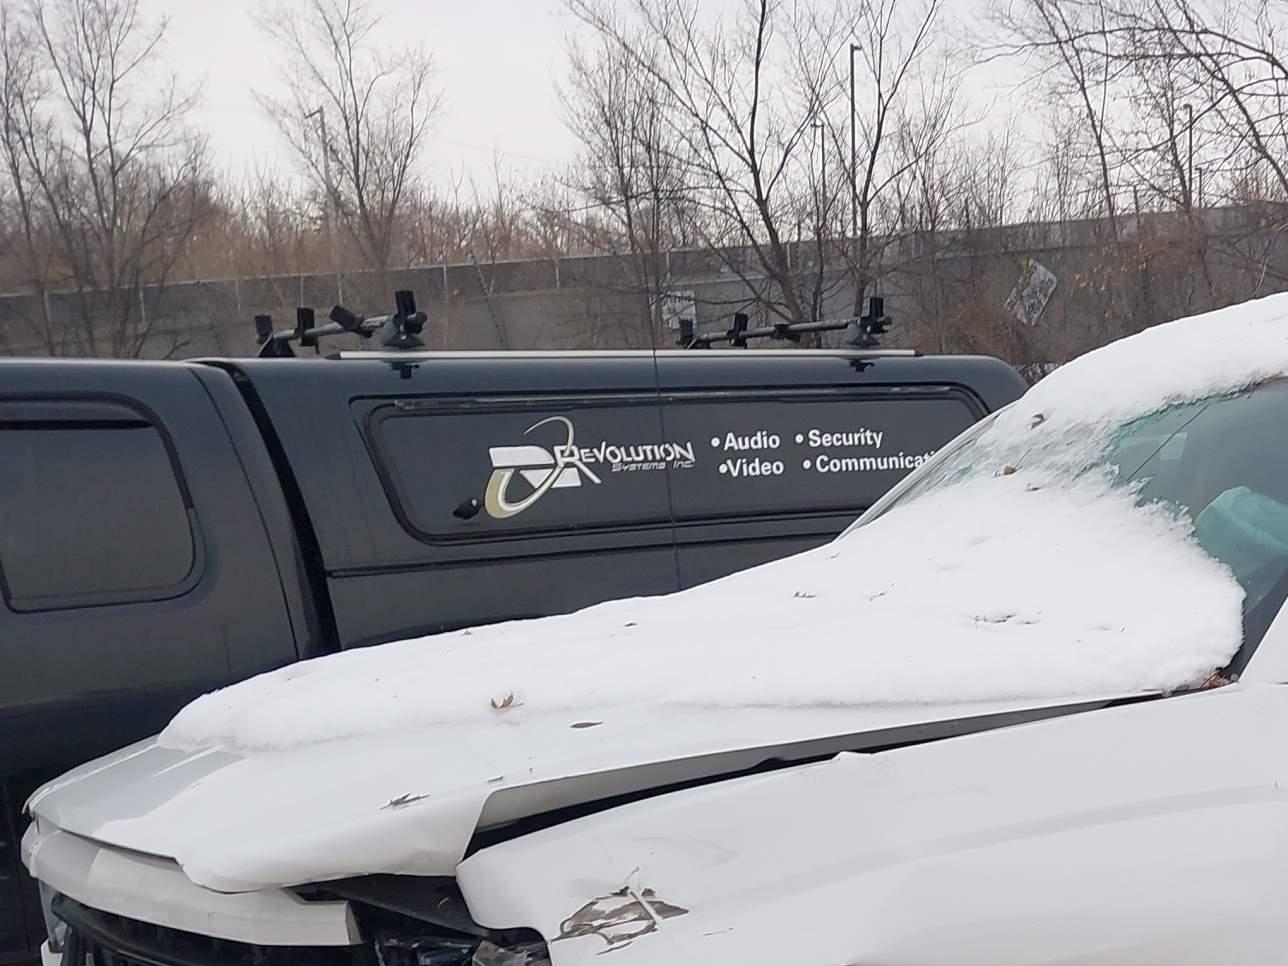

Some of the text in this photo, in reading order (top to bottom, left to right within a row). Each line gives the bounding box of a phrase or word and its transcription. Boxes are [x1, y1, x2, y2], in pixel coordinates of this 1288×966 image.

[723, 428, 883, 450] Audio Security
[726, 456, 785, 477] Video
